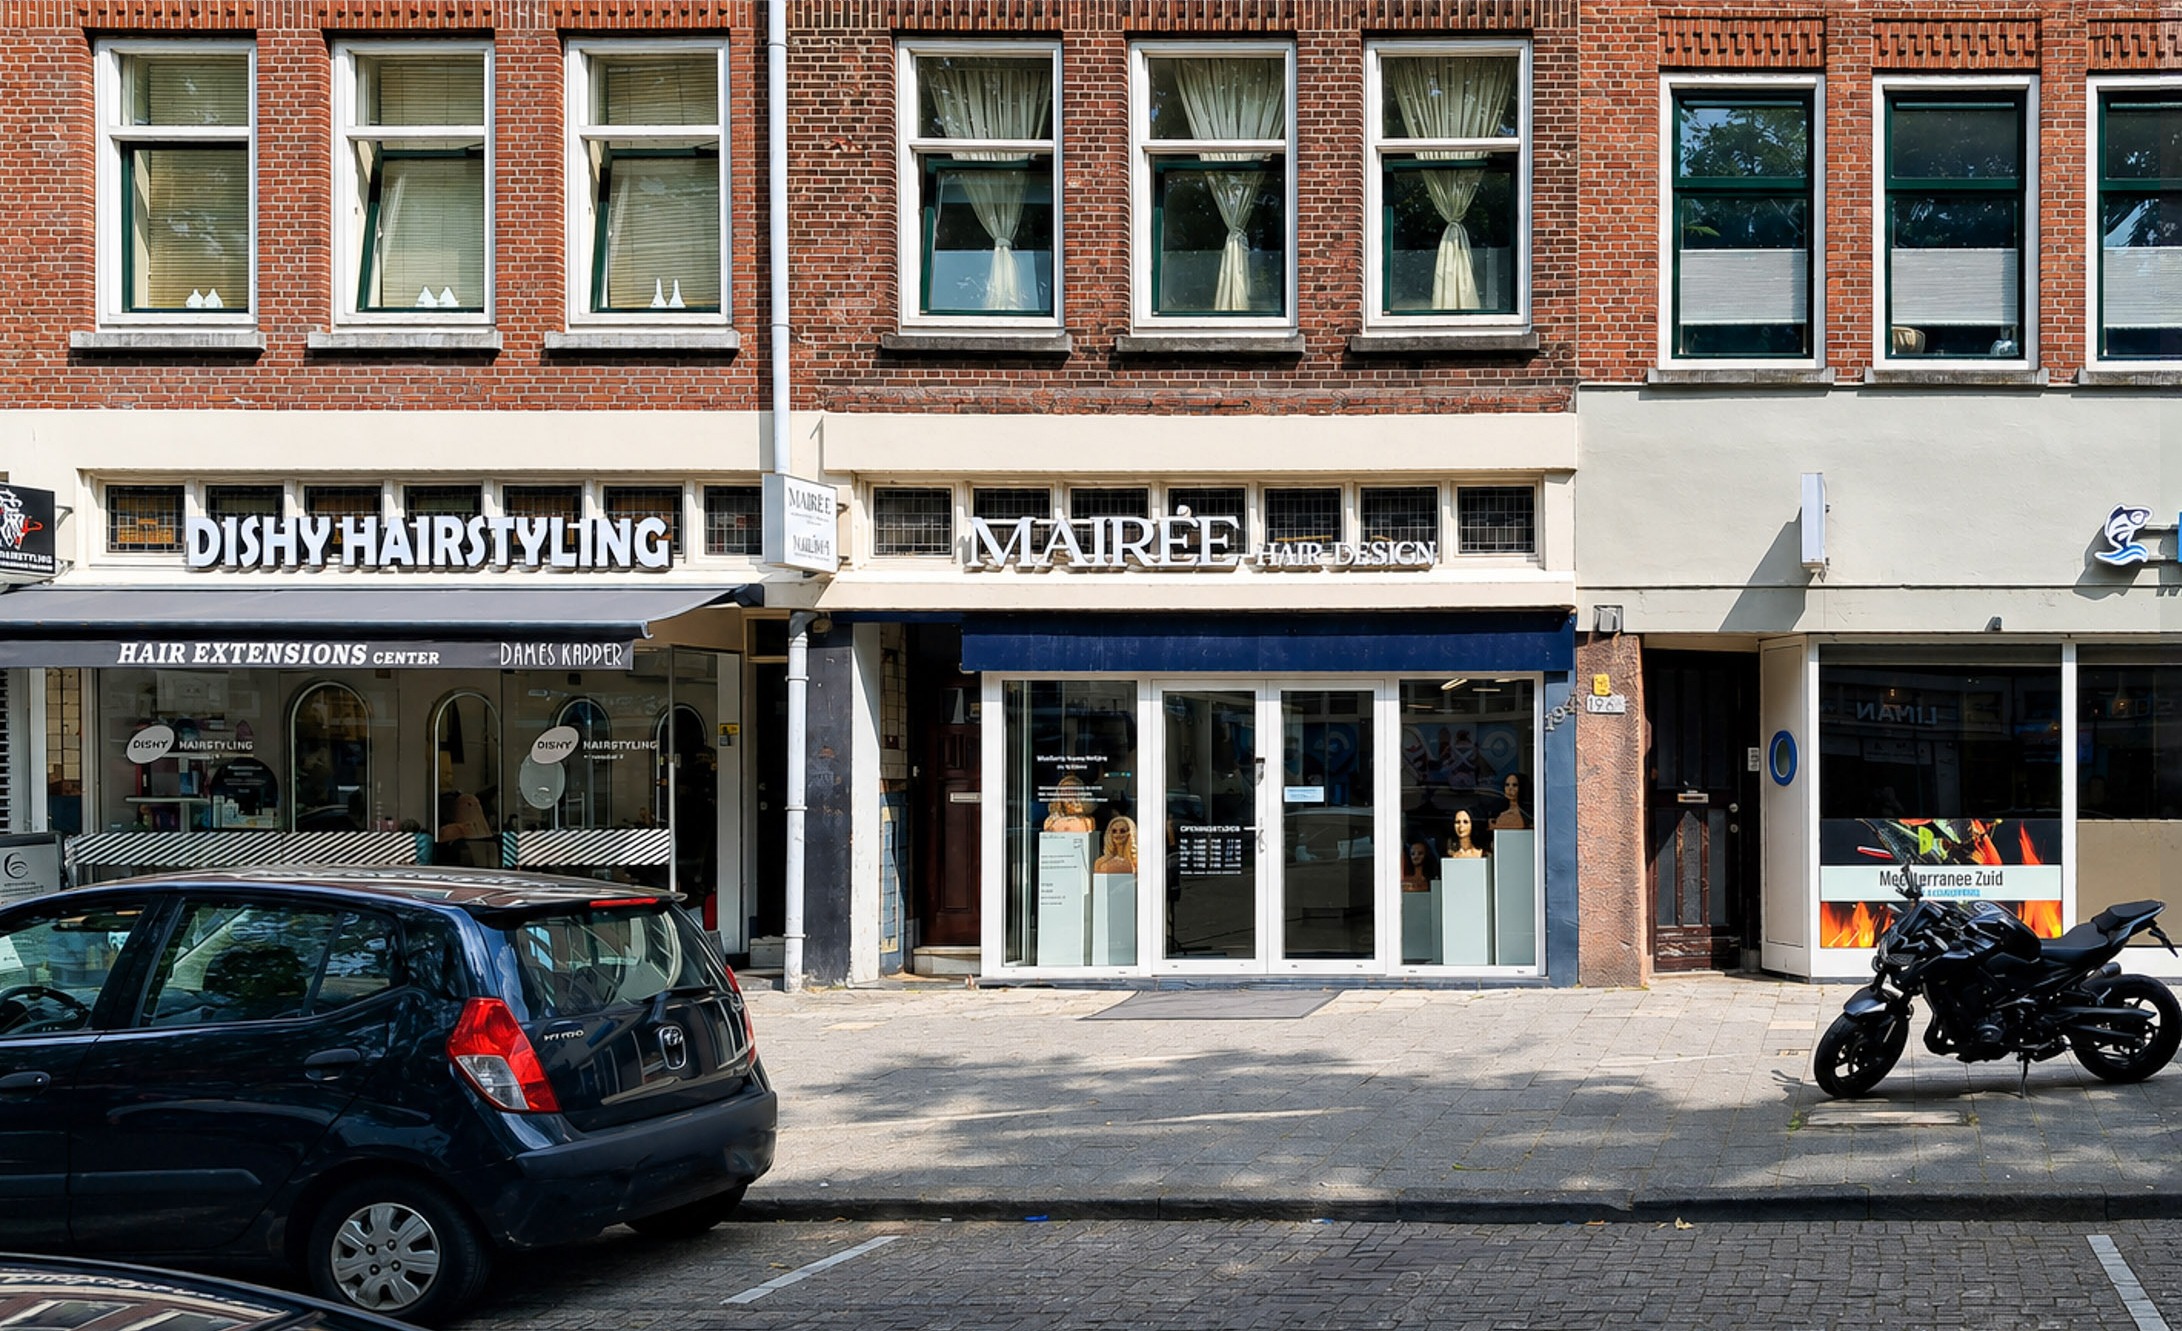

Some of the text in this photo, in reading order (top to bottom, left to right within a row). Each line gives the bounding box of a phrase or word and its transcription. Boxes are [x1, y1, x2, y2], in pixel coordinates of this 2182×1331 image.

[185, 515, 673, 569] DISHY HAIRSTYLING
[1256, 542, 1324, 567] HAIR
[1334, 541, 1437, 567] DESIGN
[117, 642, 440, 666] HAIR EXTENSIONS CENTER
[500, 642, 623, 666] DAMES KAPPER
[1879, 870, 2004, 887] Medterranee Zuid
